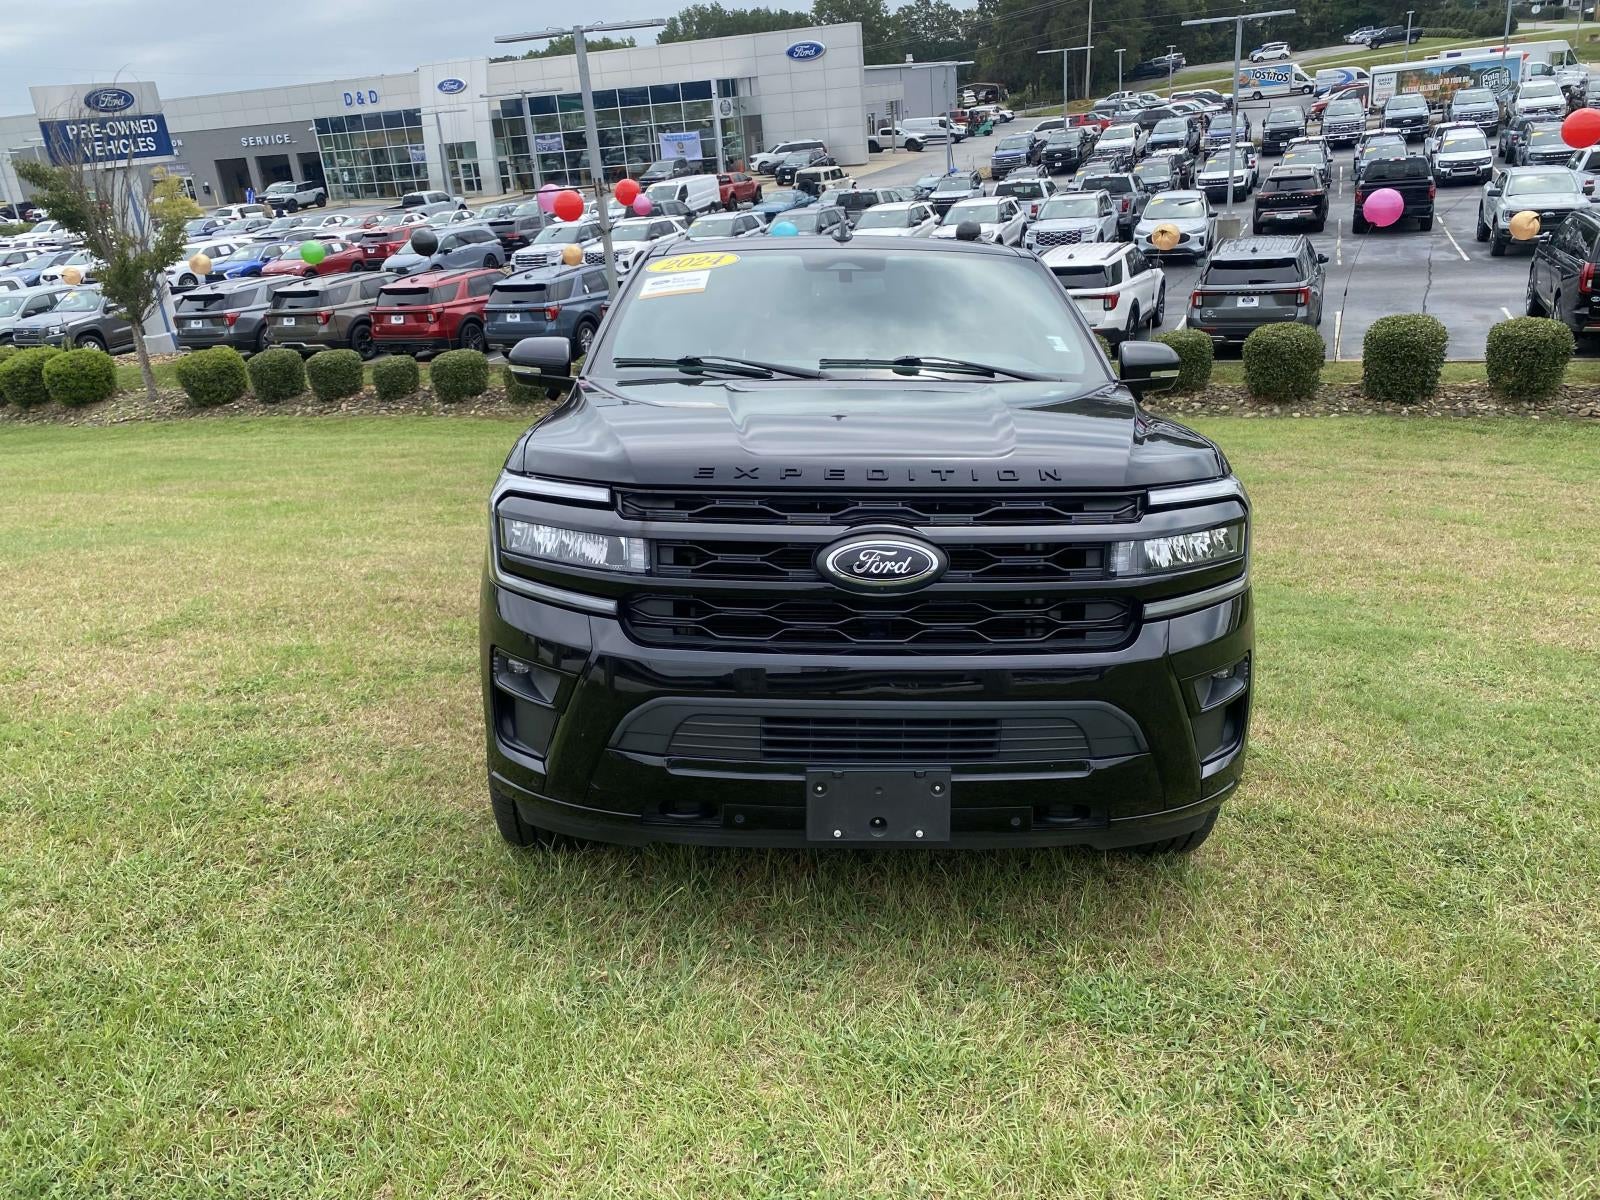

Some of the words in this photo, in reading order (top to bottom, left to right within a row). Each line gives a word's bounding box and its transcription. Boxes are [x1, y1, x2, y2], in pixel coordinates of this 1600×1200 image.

[793, 45, 816, 57] Ford
[442, 81, 459, 91] Ford
[99, 93, 125, 107] Ford
[343, 93, 353, 106] D
[356, 91, 366, 105] &
[368, 90, 378, 104] D
[66, 119, 158, 140] PRE-OWNED
[82, 137, 157, 157] VEHICLES
[241, 133, 291, 147] SERVICE
[661, 256, 724, 269] 2024
[693, 467, 1063, 483] EXPEDITION
[853, 550, 912, 575] Ford
